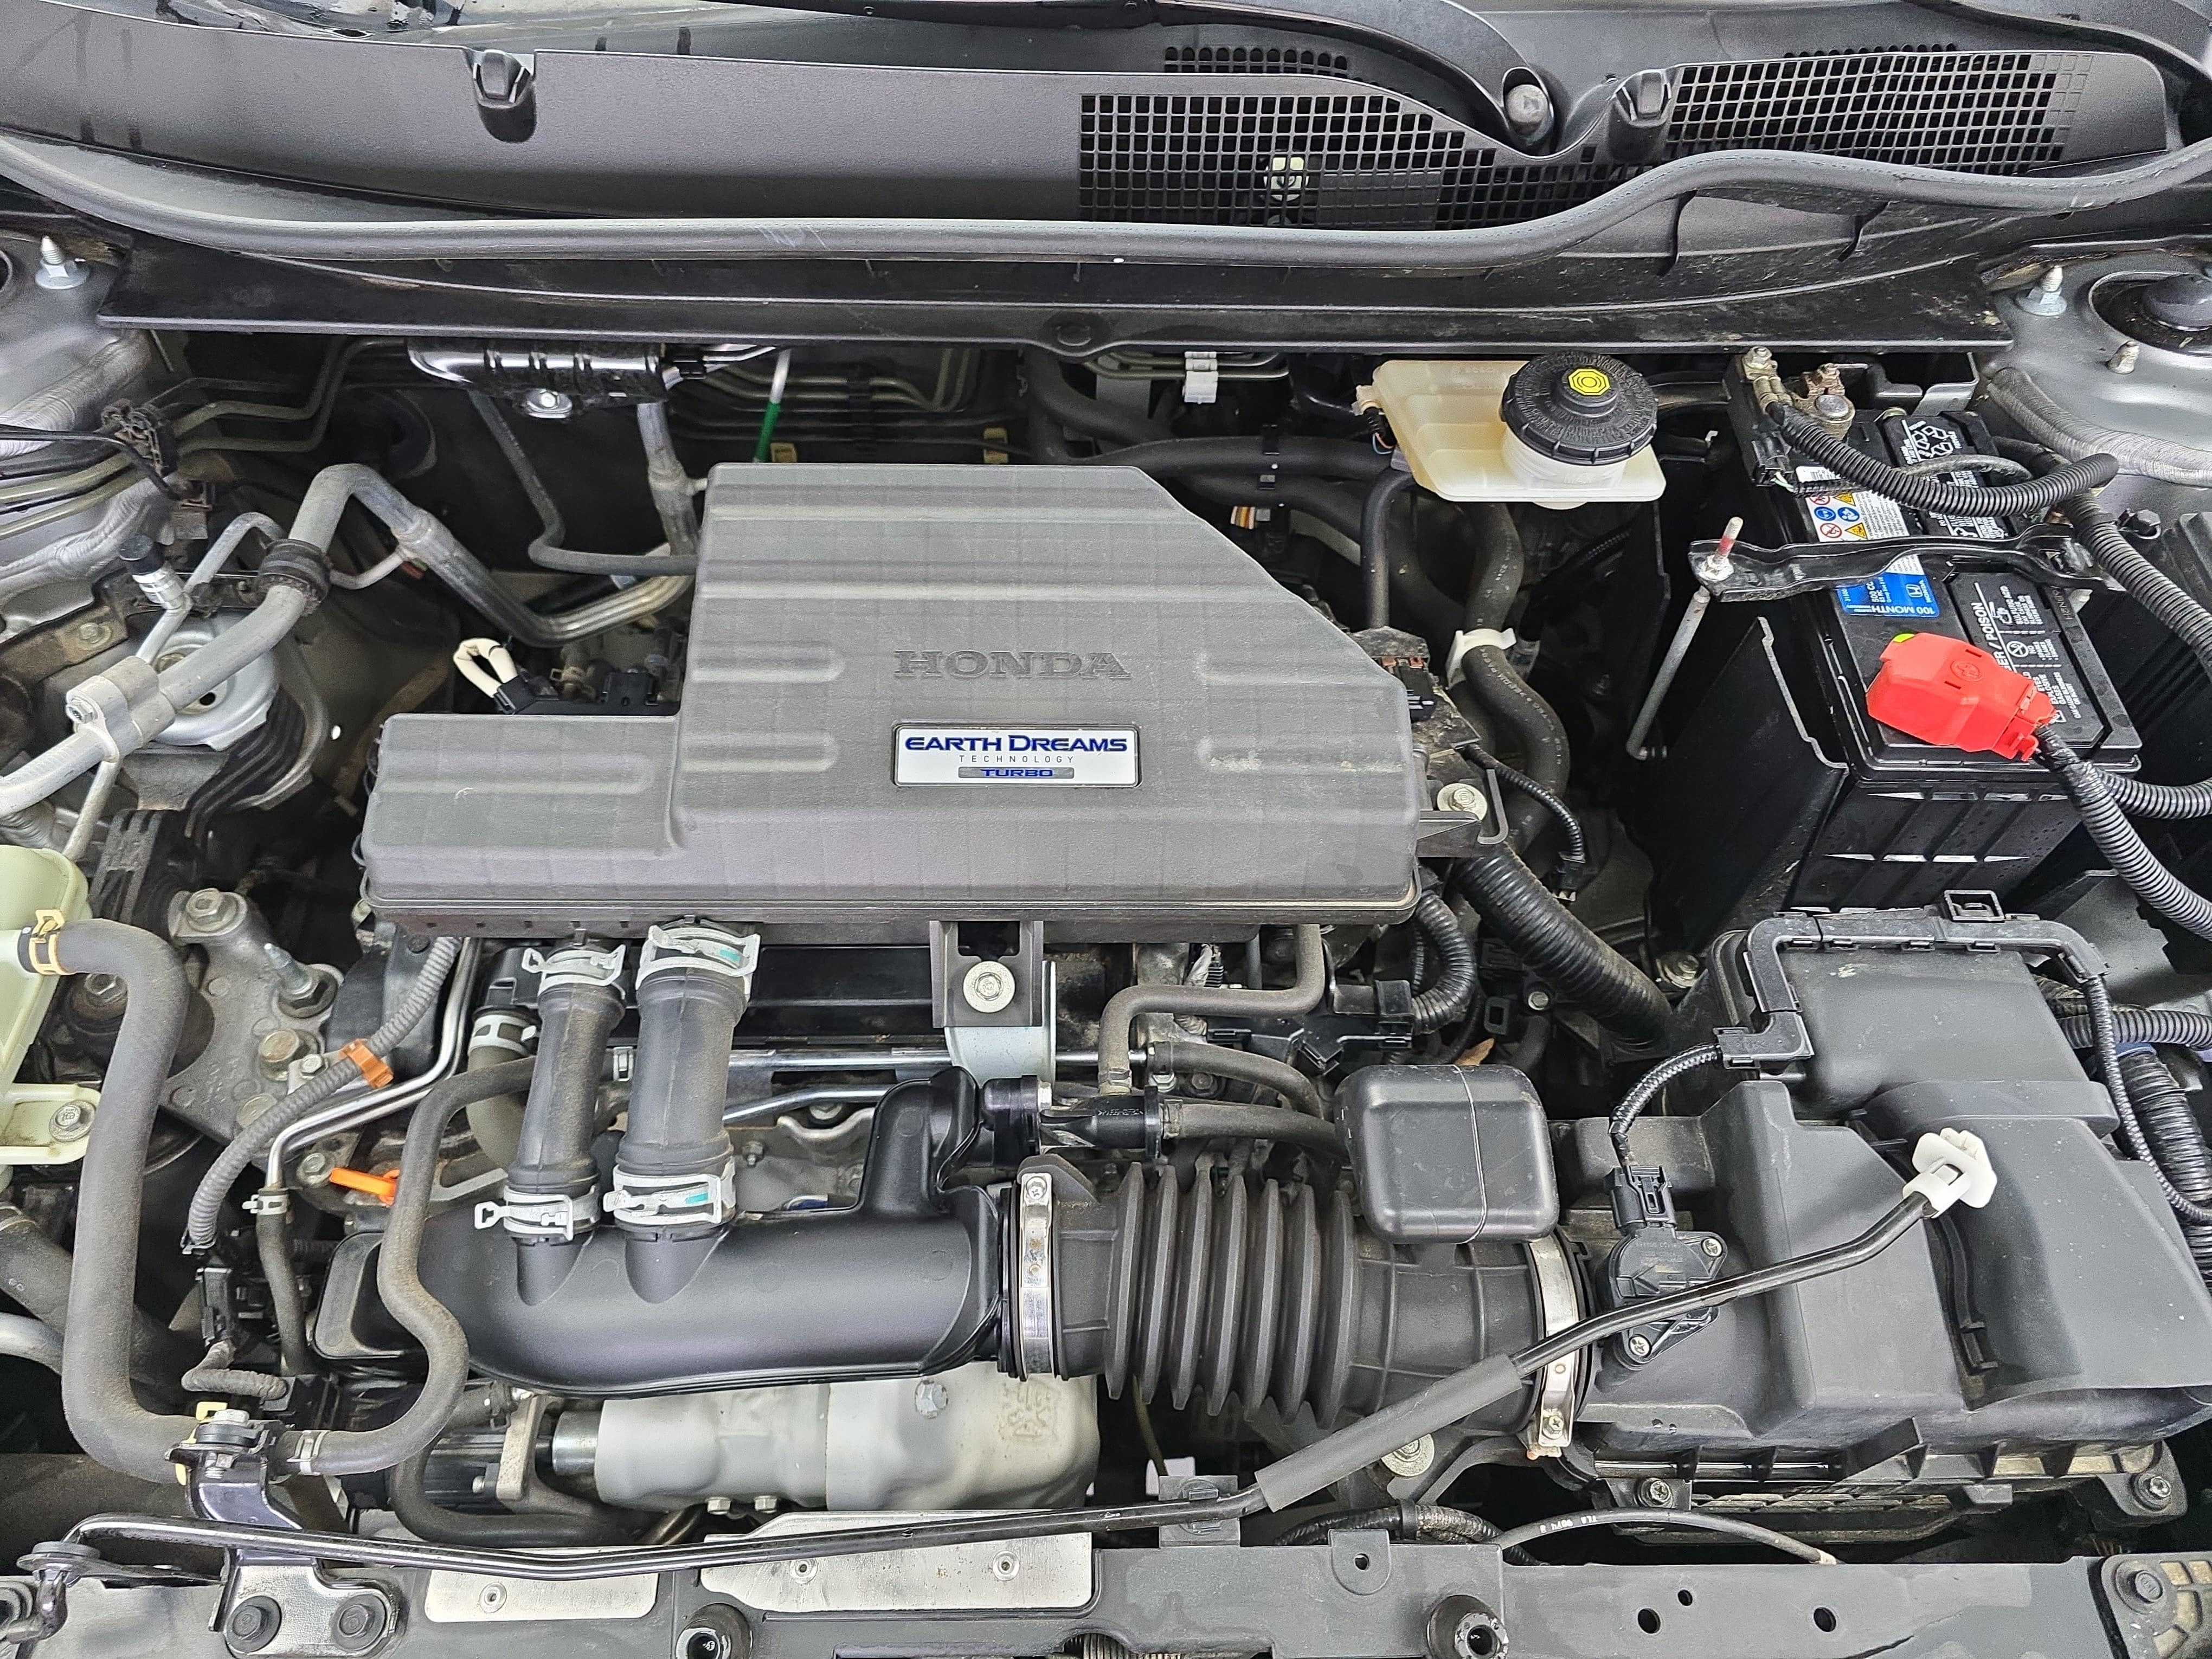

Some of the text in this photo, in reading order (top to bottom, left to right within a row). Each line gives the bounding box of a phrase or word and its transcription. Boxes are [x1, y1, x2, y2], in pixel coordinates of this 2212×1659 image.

[1870, 591, 1880, 602] 500
[1919, 580, 1932, 603] HONDA
[2000, 586, 2012, 599] ACID
[1872, 605, 1915, 613] MONTH
[1971, 602, 1998, 640] POISON
[2028, 646, 2036, 654] NO
[893, 650, 1131, 678] HONDA
[2033, 677, 2045, 692] EYES
[2039, 674, 2059, 704] EXPLOSIVE
[2052, 685, 2067, 704] GASES
[905, 735, 1128, 753] EARTH DREAMS
[959, 755, 1075, 763] TECHNOLOGY
[980, 769, 1053, 777] TURBO
